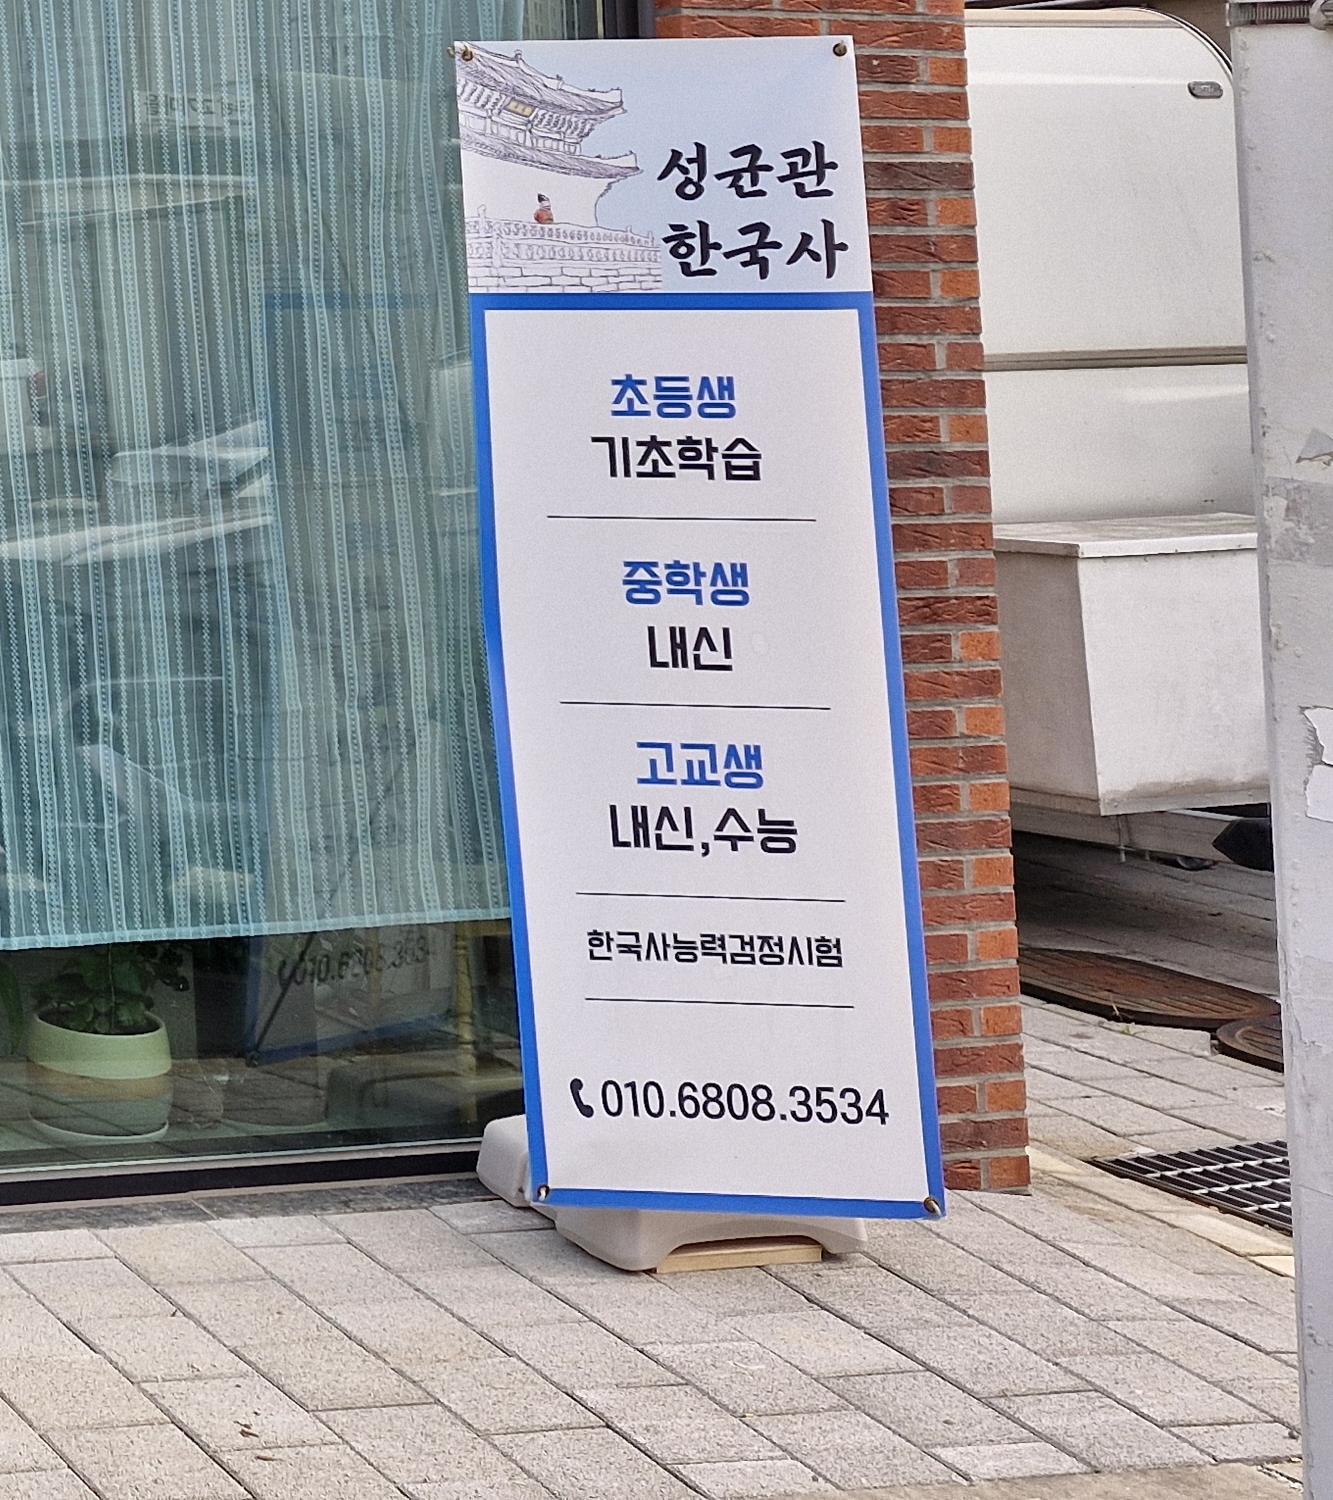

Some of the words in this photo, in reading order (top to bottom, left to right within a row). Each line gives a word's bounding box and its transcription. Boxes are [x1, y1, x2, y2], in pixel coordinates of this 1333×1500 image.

[657, 140, 839, 201] 성균관
[660, 218, 850, 280] 한국사
[609, 372, 737, 420] 초등생
[590, 435, 763, 482] 기초학습
[621, 559, 750, 607] 중학생
[647, 624, 734, 672] 내신
[635, 741, 765, 790] 고교생
[608, 804, 799, 857] 내신,수능
[585, 929, 844, 969] 한국사능력검정시험
[600, 1079, 890, 1127] 010.6808.3534
